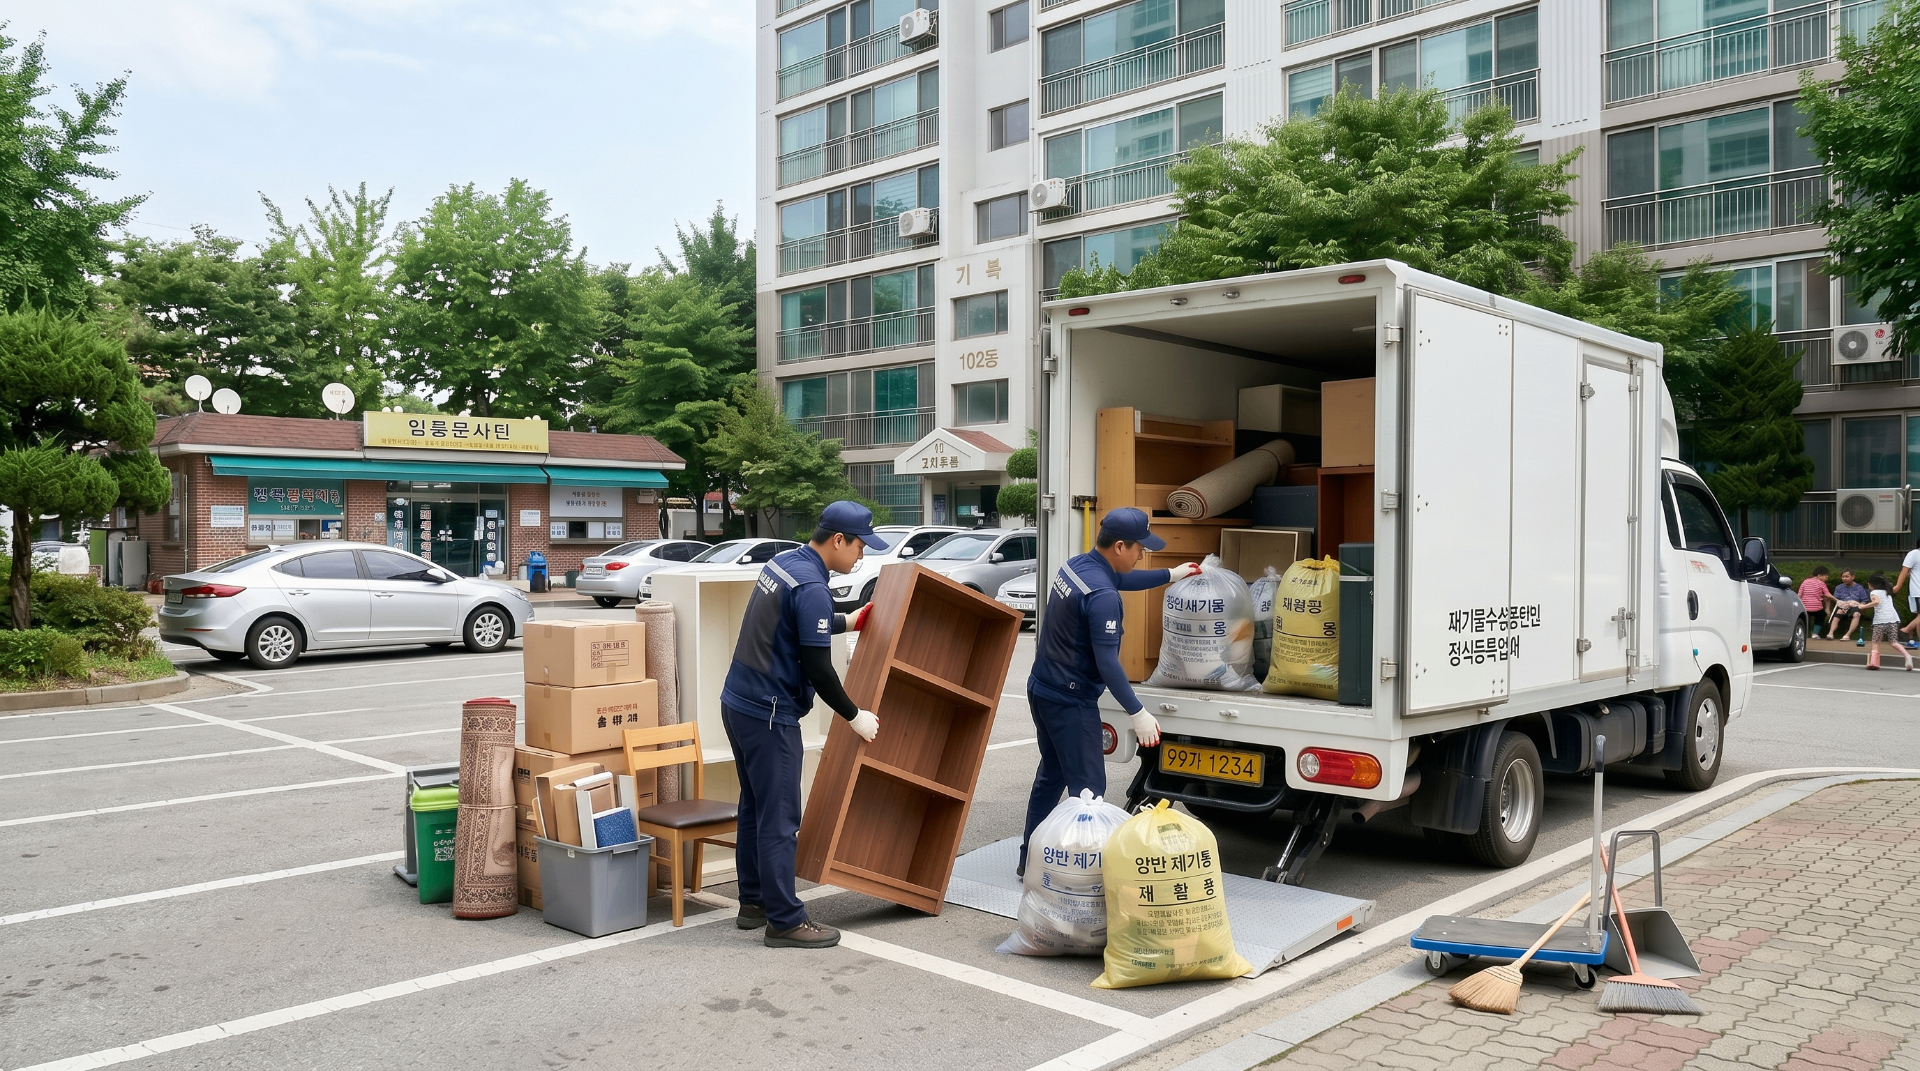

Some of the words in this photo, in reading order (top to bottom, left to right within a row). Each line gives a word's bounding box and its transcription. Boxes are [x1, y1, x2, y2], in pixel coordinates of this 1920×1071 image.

[959, 348, 999, 370] 102동
[1167, 748, 1202, 770] 99가
[1209, 753, 1255, 778] 1234
[1135, 856, 1167, 875] 앙반
[1138, 885, 1154, 903] 재
